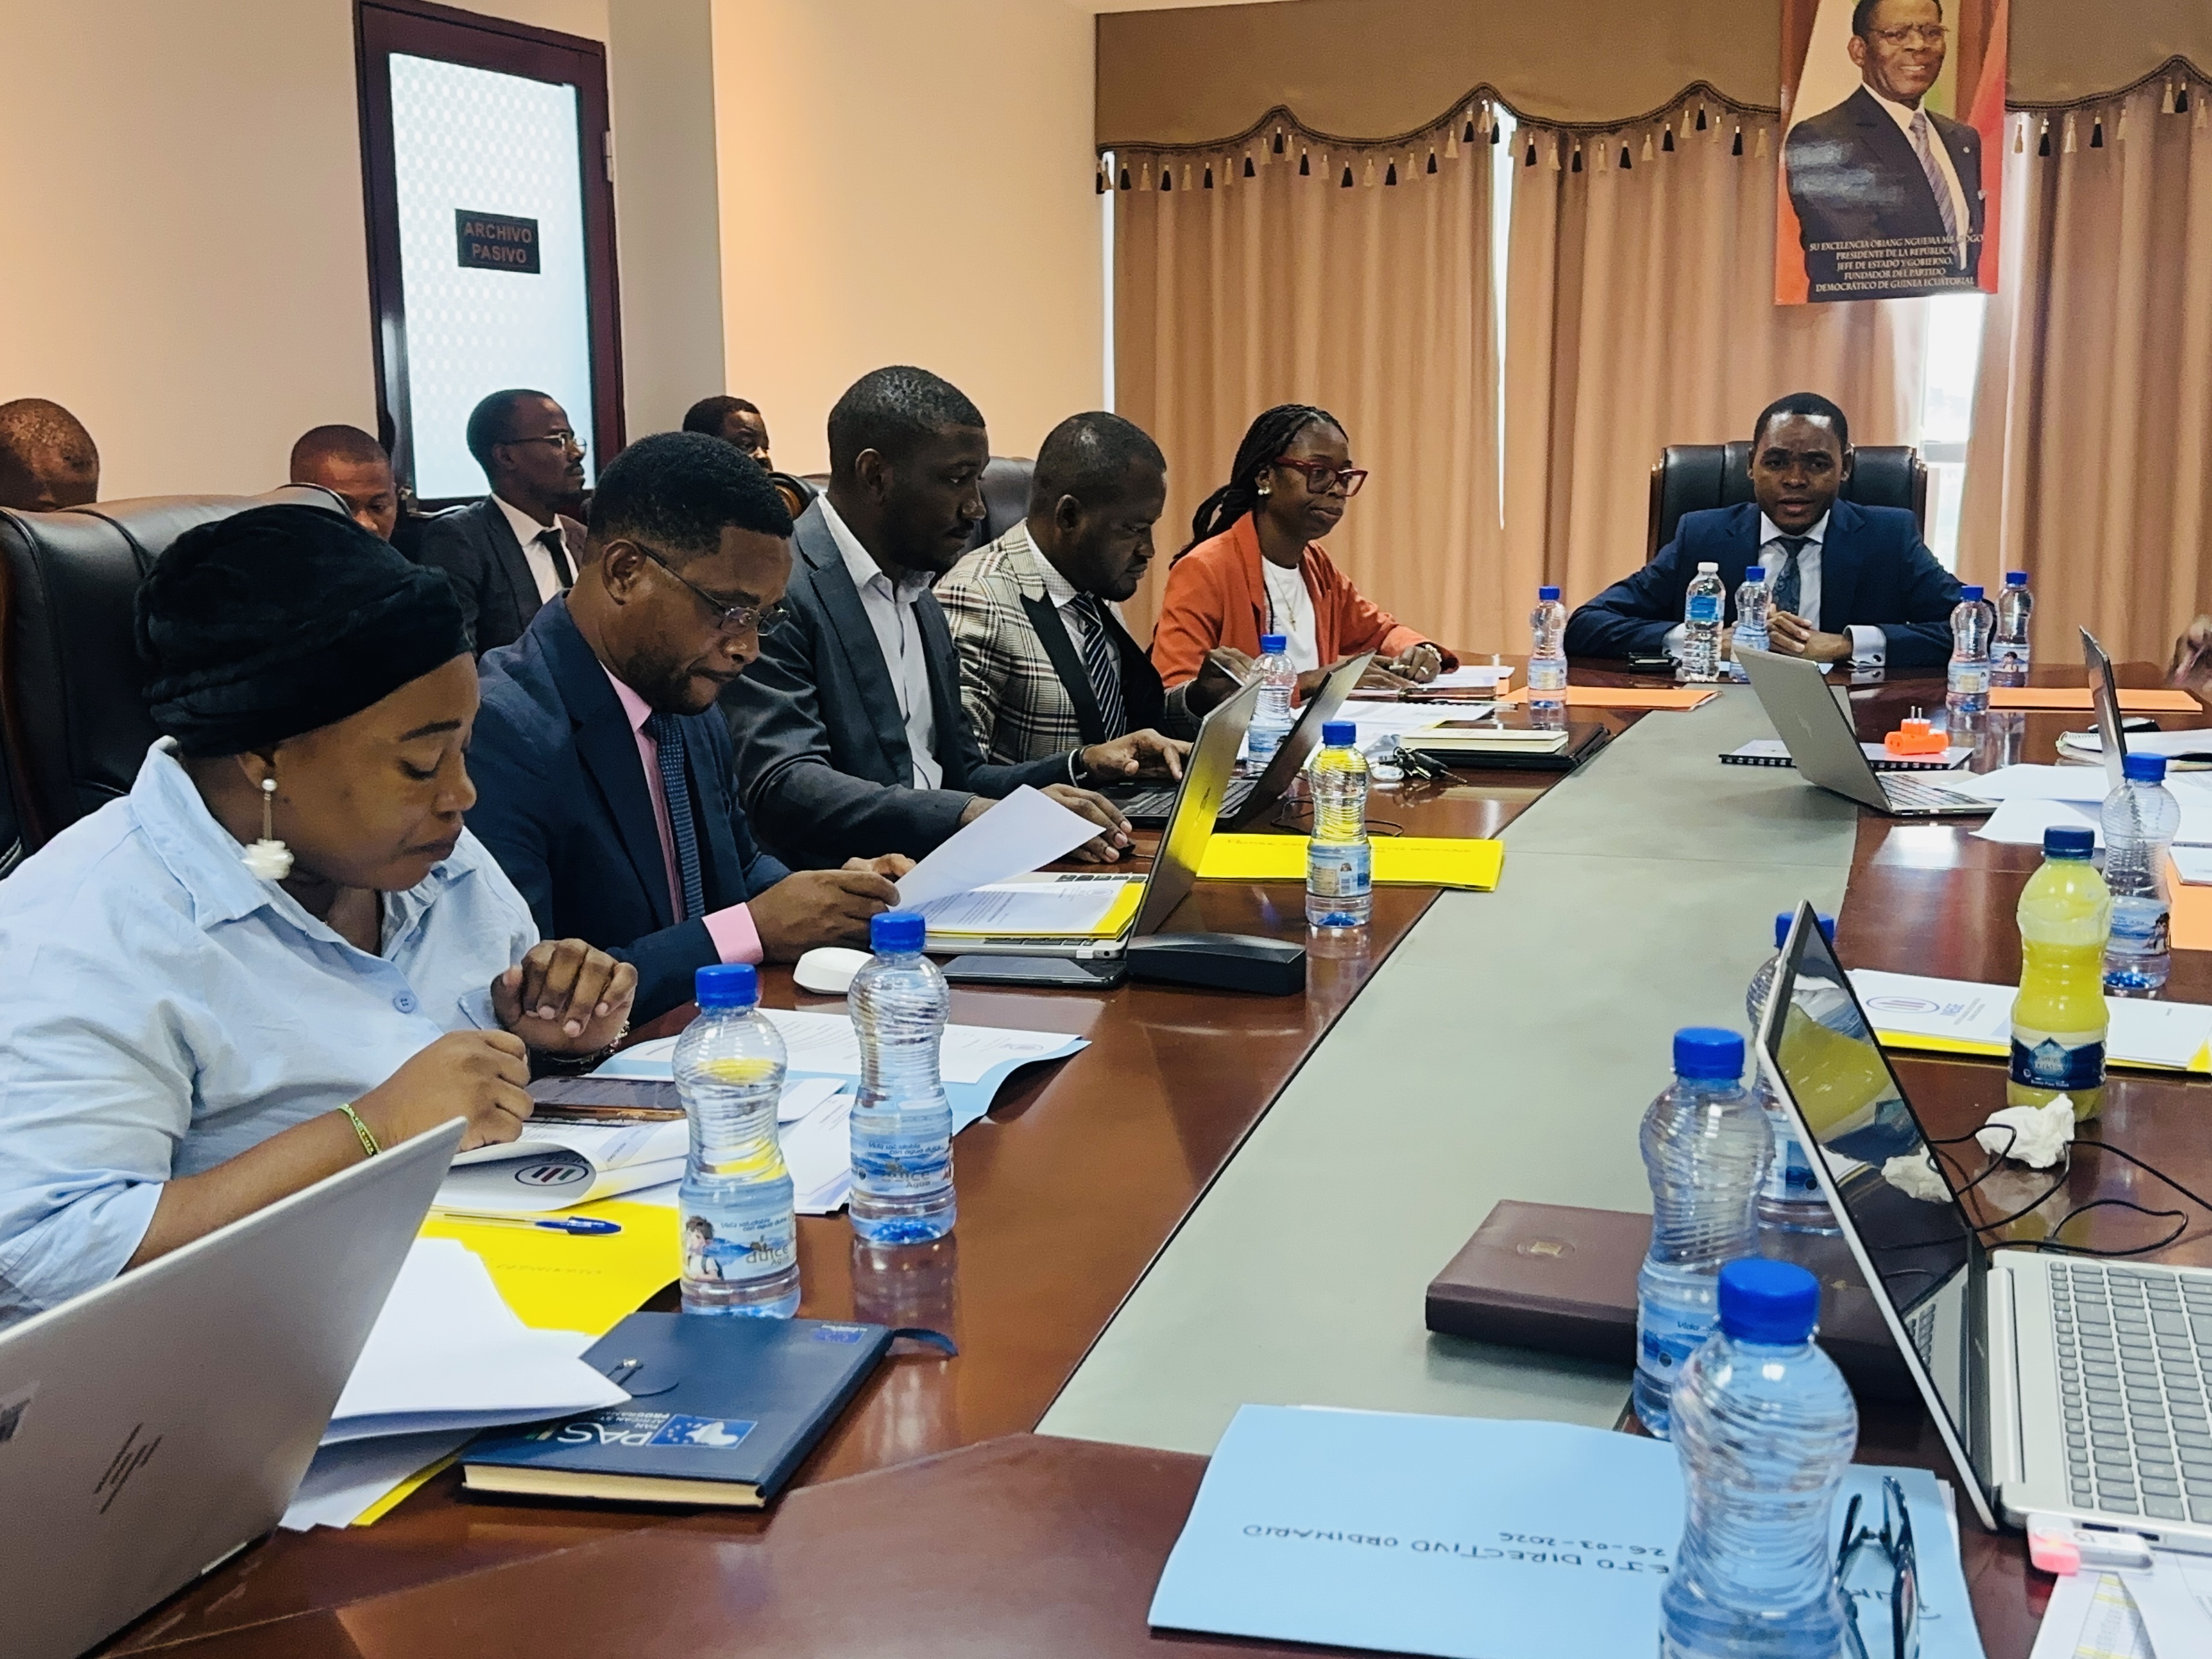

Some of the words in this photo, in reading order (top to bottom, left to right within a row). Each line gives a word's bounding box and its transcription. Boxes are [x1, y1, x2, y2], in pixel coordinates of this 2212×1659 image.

[464, 221, 532, 243] ARCHIVO
[1810, 243, 1820, 251] SU
[1821, 240, 1869, 250] EXCELENCIA
[1870, 238, 1903, 248] OBIANG
[1905, 236, 1941, 246] NGUEMA
[472, 243, 527, 264] PASIVO
[1836, 249, 1884, 260] PRESIDENTE
[1886, 249, 1898, 258] DE
[1899, 248, 1908, 256] LA
[1837, 261, 1854, 272] JEFE
[1855, 261, 1866, 270] DE
[1868, 259, 1899, 269] ESTADO
[1901, 259, 1905, 267] Y
[1844, 270, 1891, 281] FUNDADOR
[1892, 268, 1907, 278] DEL
[1909, 267, 1947, 276] PARTIDO
[1878, 281, 1889, 289] DE
[1890, 279, 1922, 289] GUINEA
[1924, 276, 1974, 287] ECUATORIAL
[556, 1422, 653, 1446] PAS
[1242, 1524, 1399, 1547] ORDINARIO
[1410, 1539, 1582, 1566] DIRECTIVO
[1596, 1558, 1670, 1574] EJO
